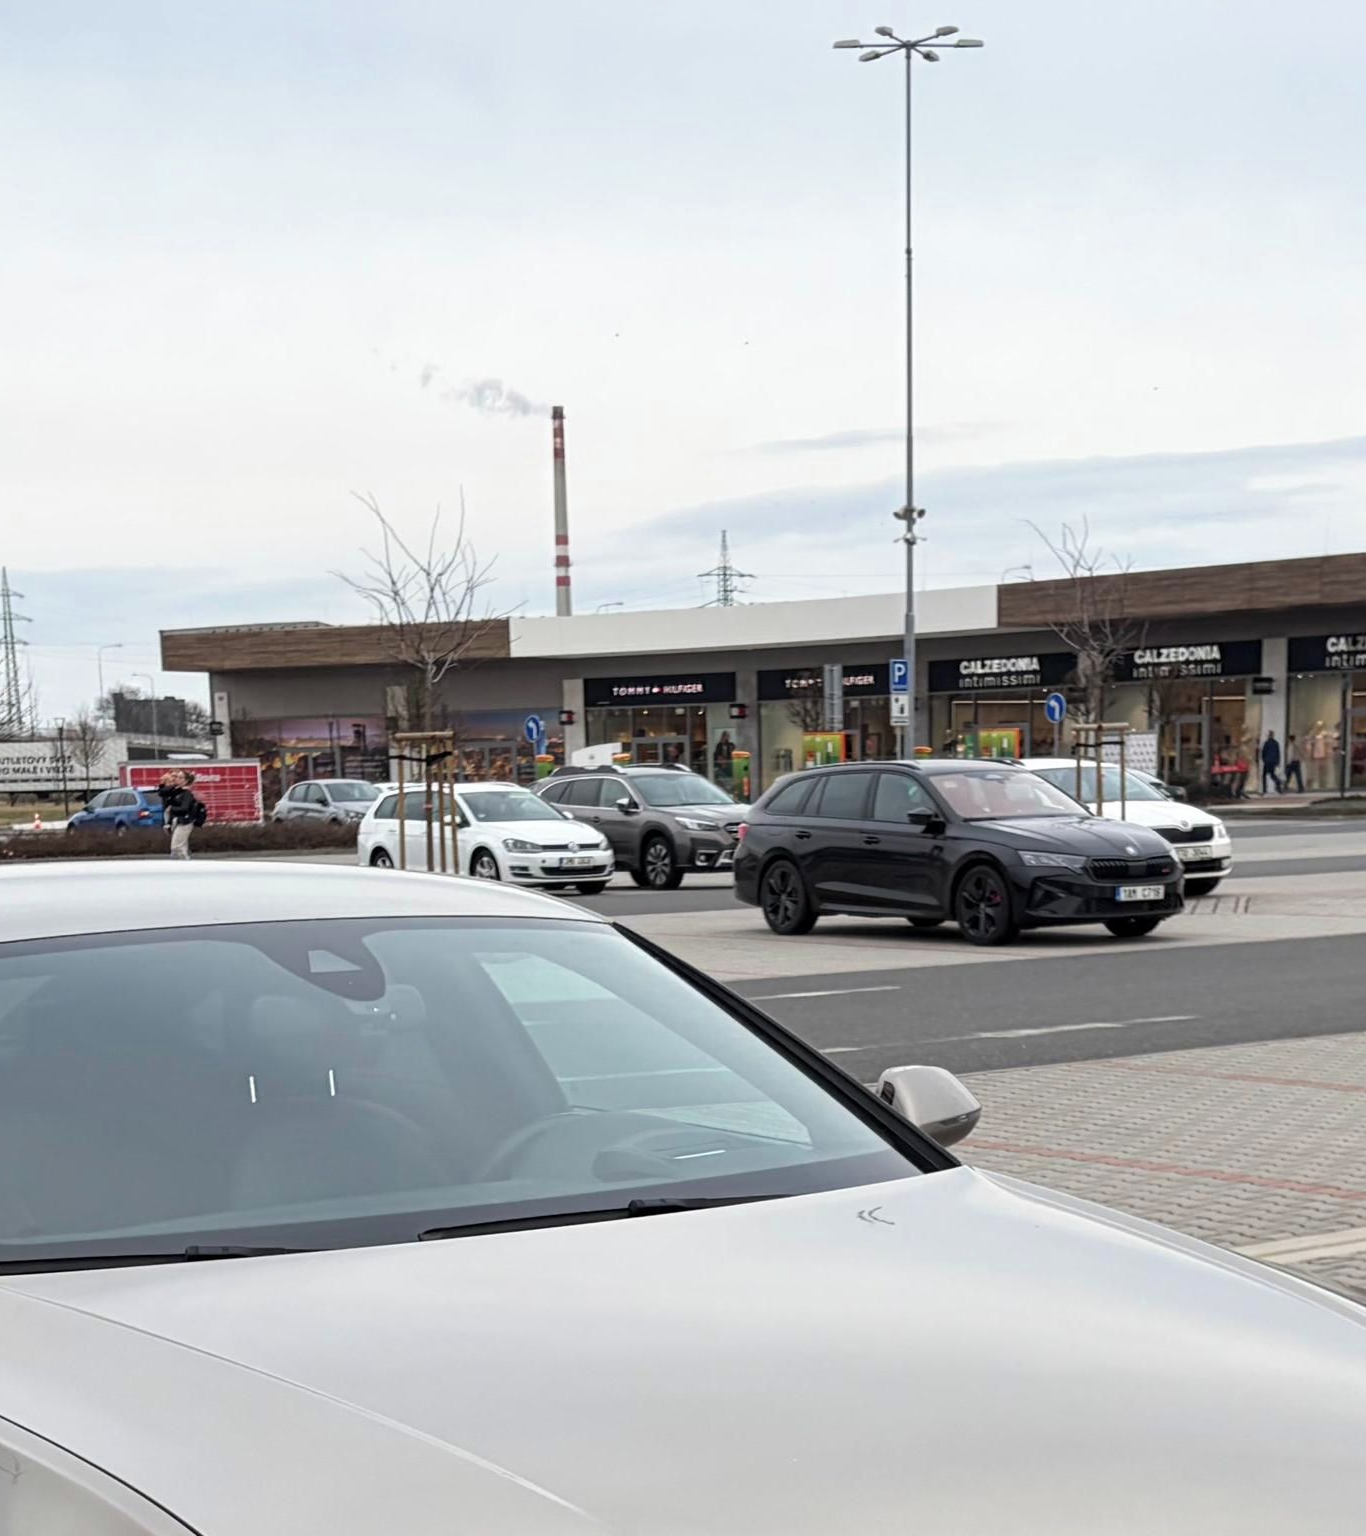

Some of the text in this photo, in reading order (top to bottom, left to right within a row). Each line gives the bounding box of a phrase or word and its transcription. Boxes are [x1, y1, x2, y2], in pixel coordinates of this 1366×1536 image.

[1133, 644, 1222, 664] CALZEDONIA
[894, 663, 906, 683] P
[959, 657, 1040, 674] CALZEDONIA
[959, 673, 1041, 688] intimissimi
[612, 684, 703, 696] TOMMY HILFIGER
